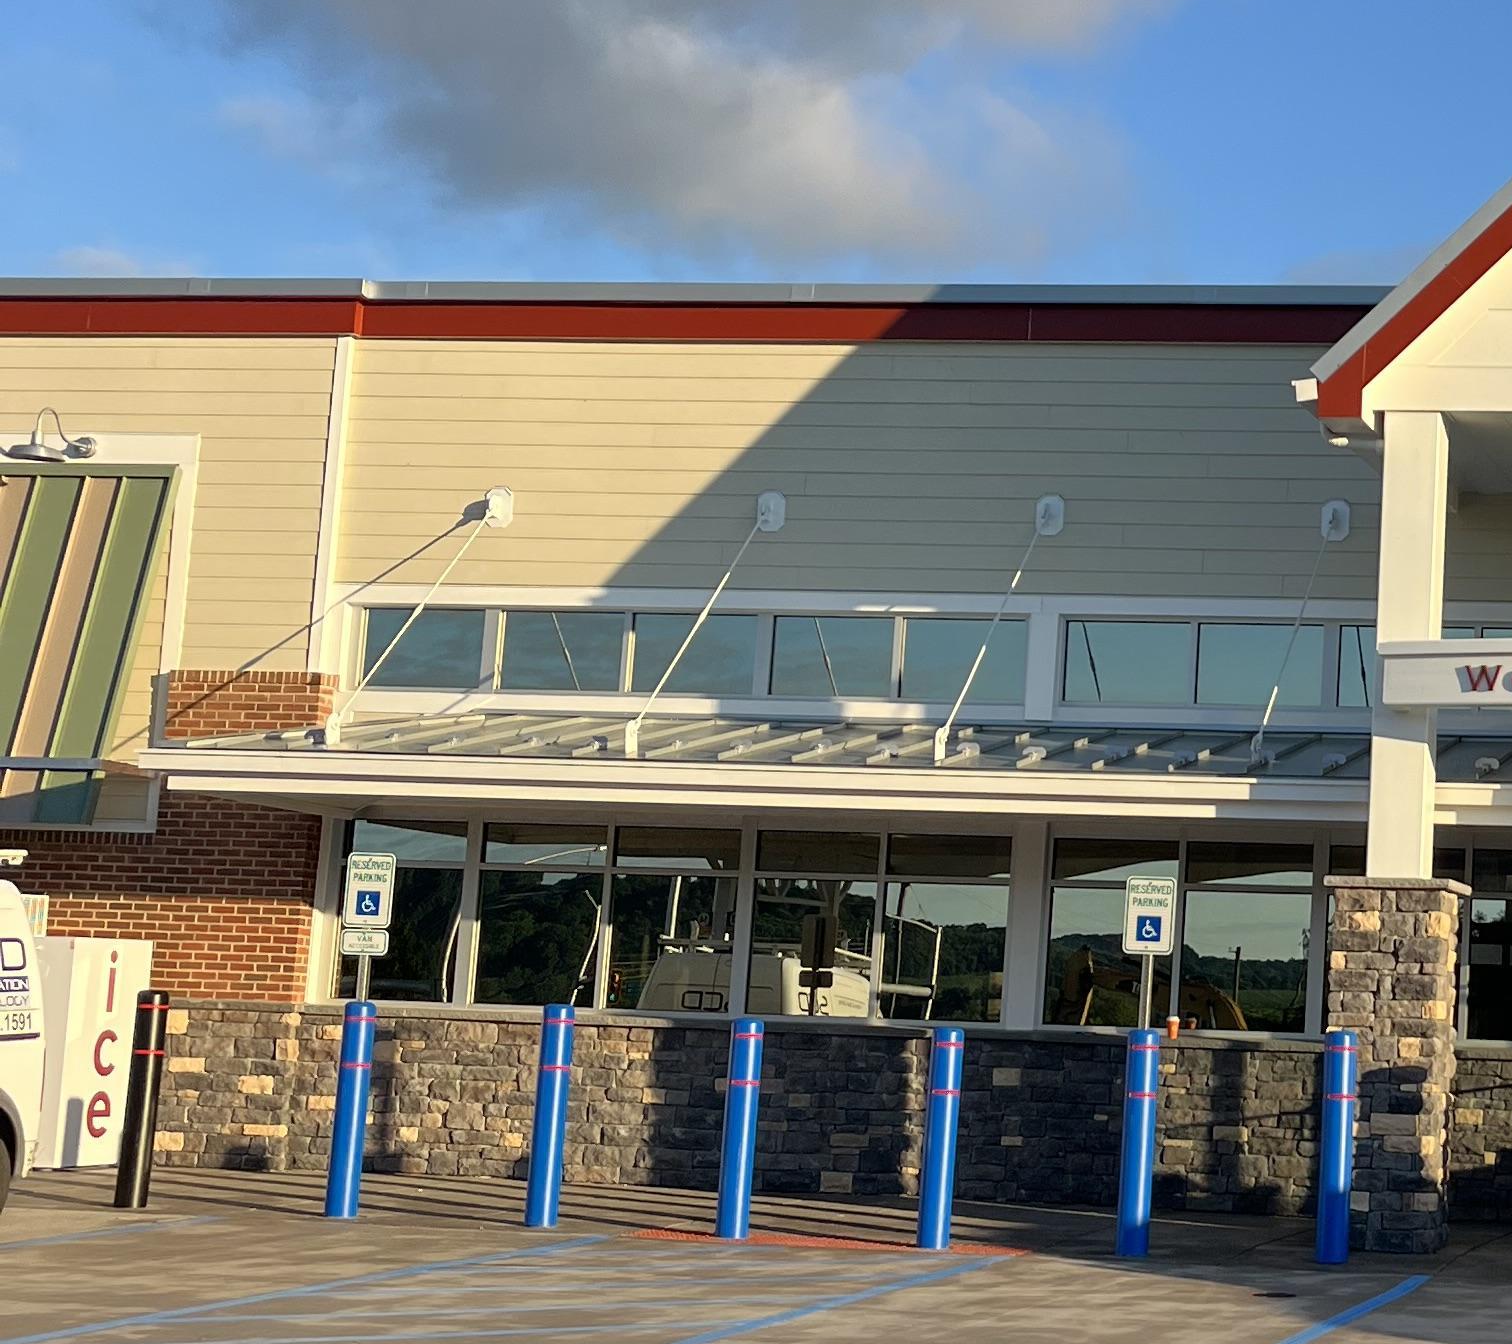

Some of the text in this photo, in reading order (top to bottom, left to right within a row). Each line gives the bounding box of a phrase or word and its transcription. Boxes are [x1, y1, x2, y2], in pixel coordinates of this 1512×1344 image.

[352, 860, 391, 870] RESERVED
[353, 873, 388, 883] PARKING
[1130, 884, 1172, 895] RESERVED
[1132, 897, 1169, 908] PARKING
